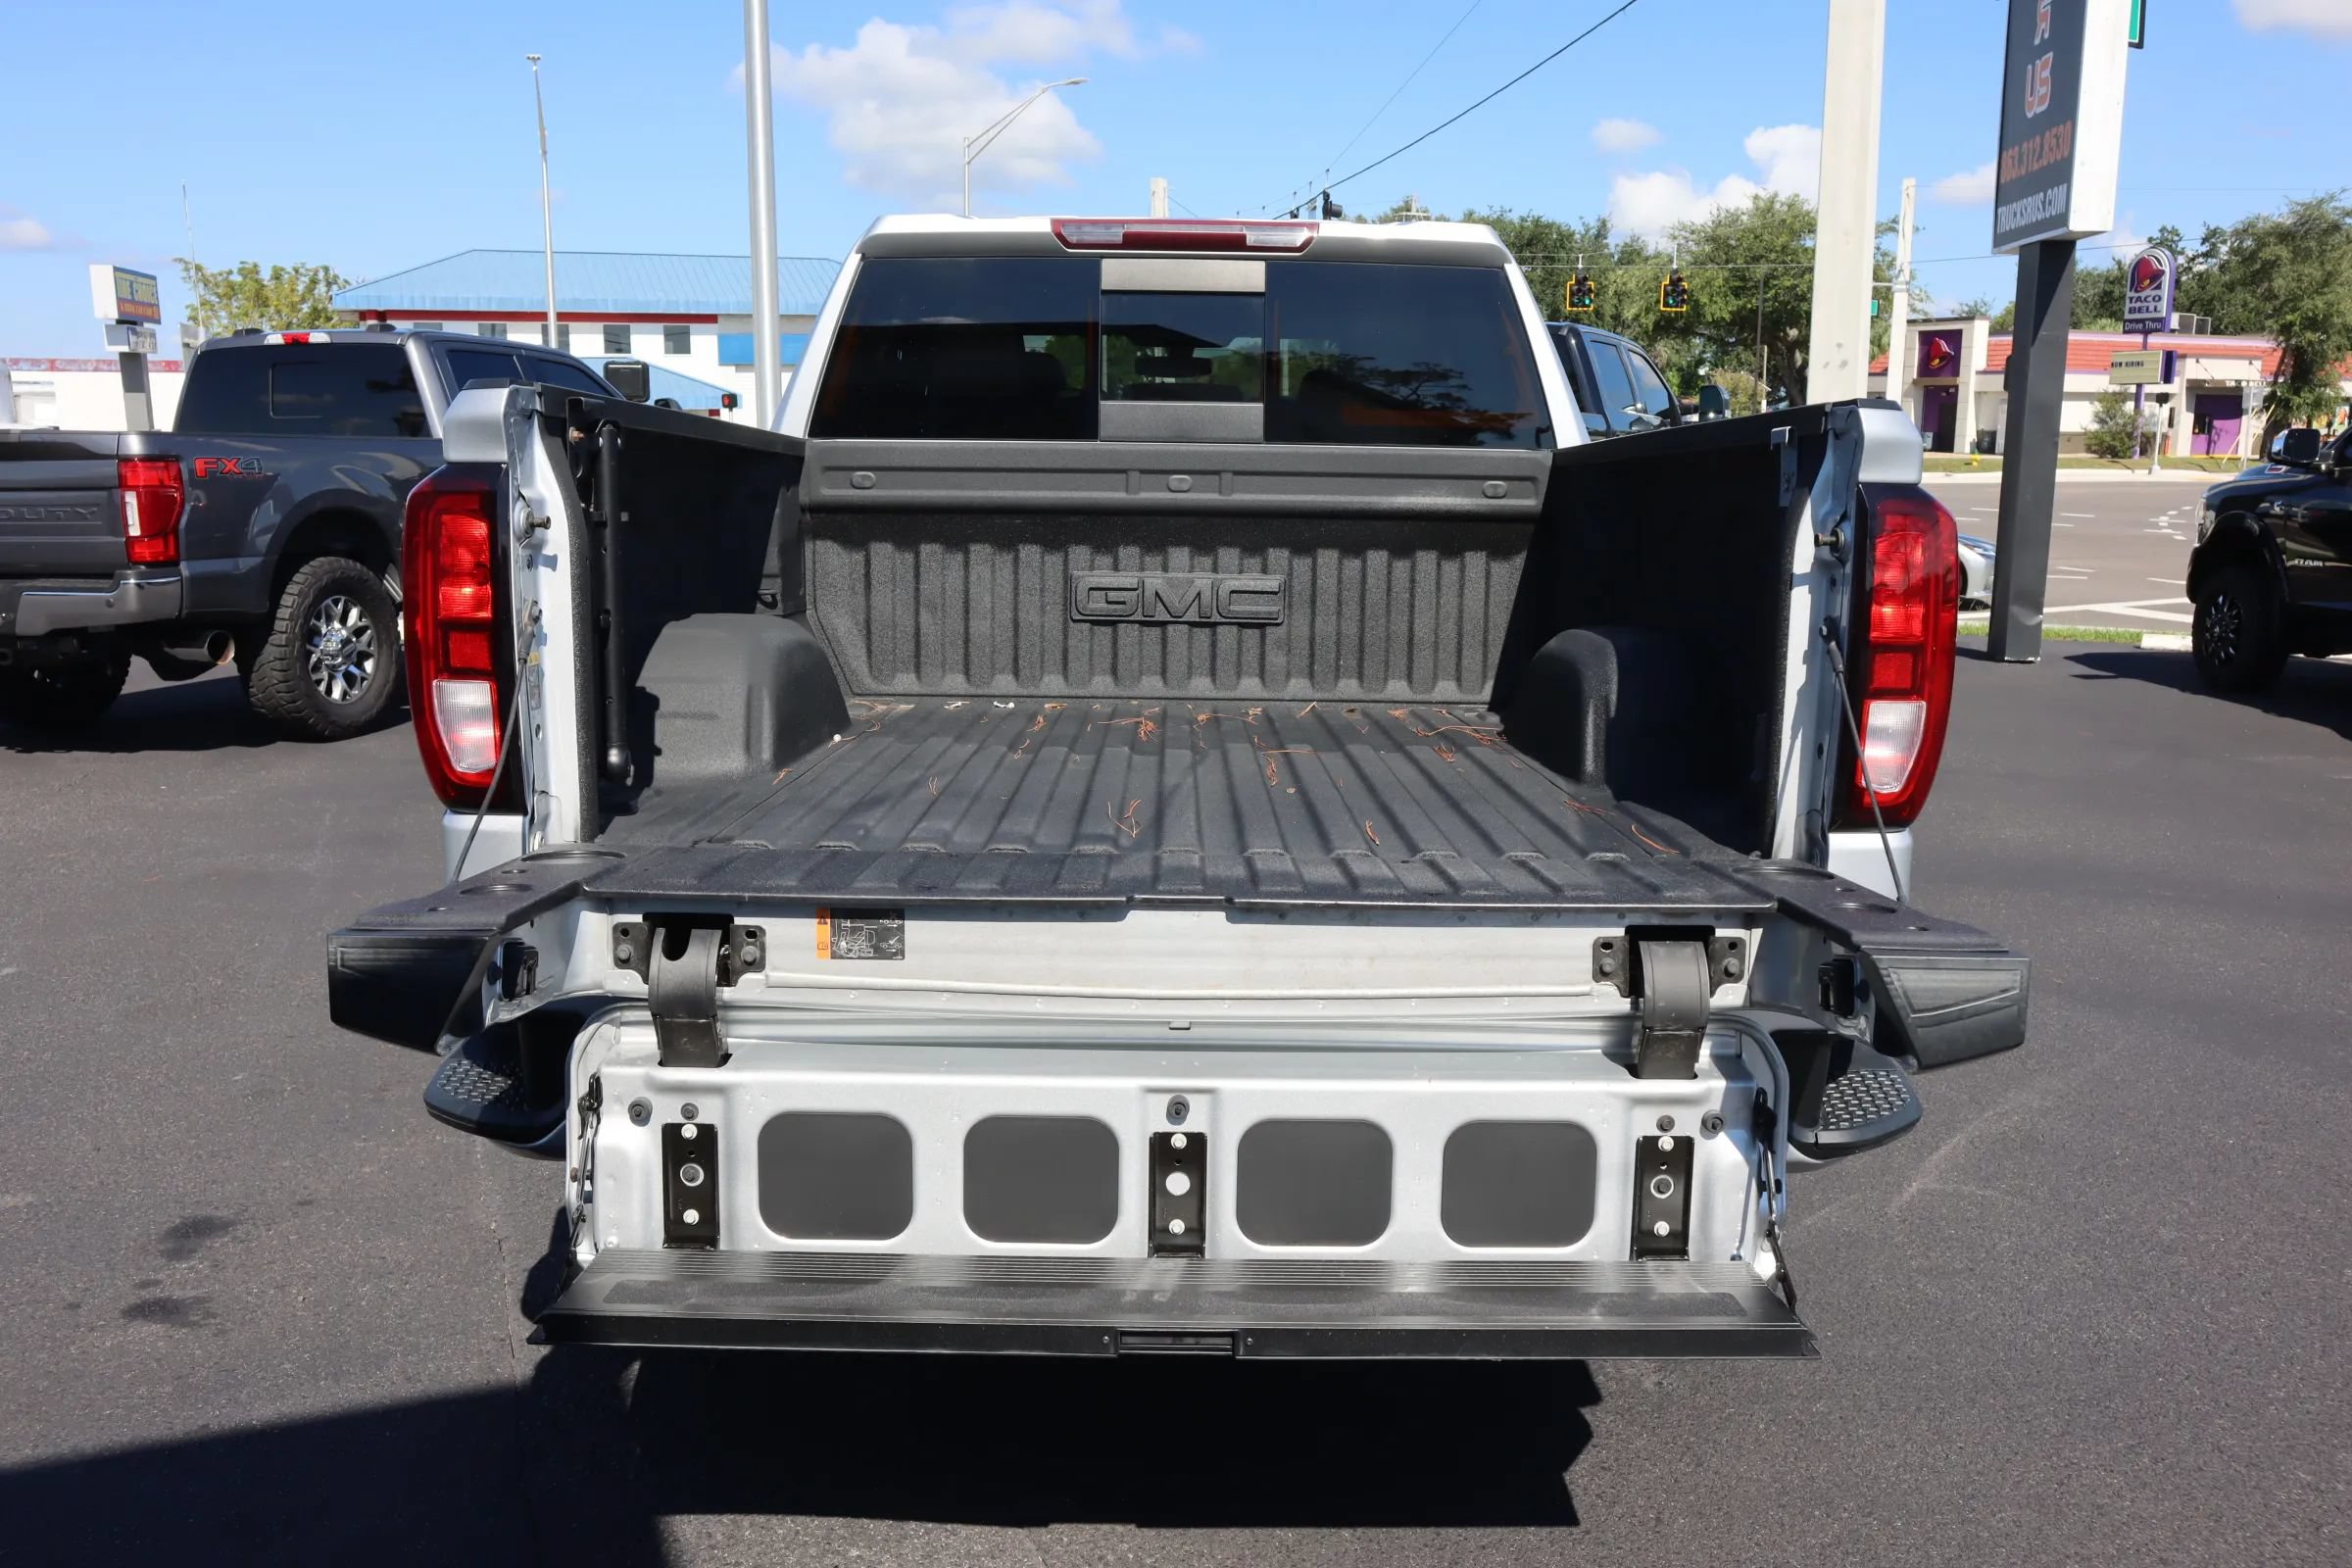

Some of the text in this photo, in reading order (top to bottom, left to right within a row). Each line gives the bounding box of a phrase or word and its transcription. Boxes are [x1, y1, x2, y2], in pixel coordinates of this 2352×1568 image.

[2025, 51, 2054, 119] US
[1997, 183, 2068, 234] TRUCKSRUS.COM
[2128, 295, 2162, 304] TACO
[2125, 320, 2162, 330] Drive Thru
[193, 457, 264, 479] FX4
[2294, 559, 2324, 567] RAM
[1074, 576, 1282, 620] GMC
